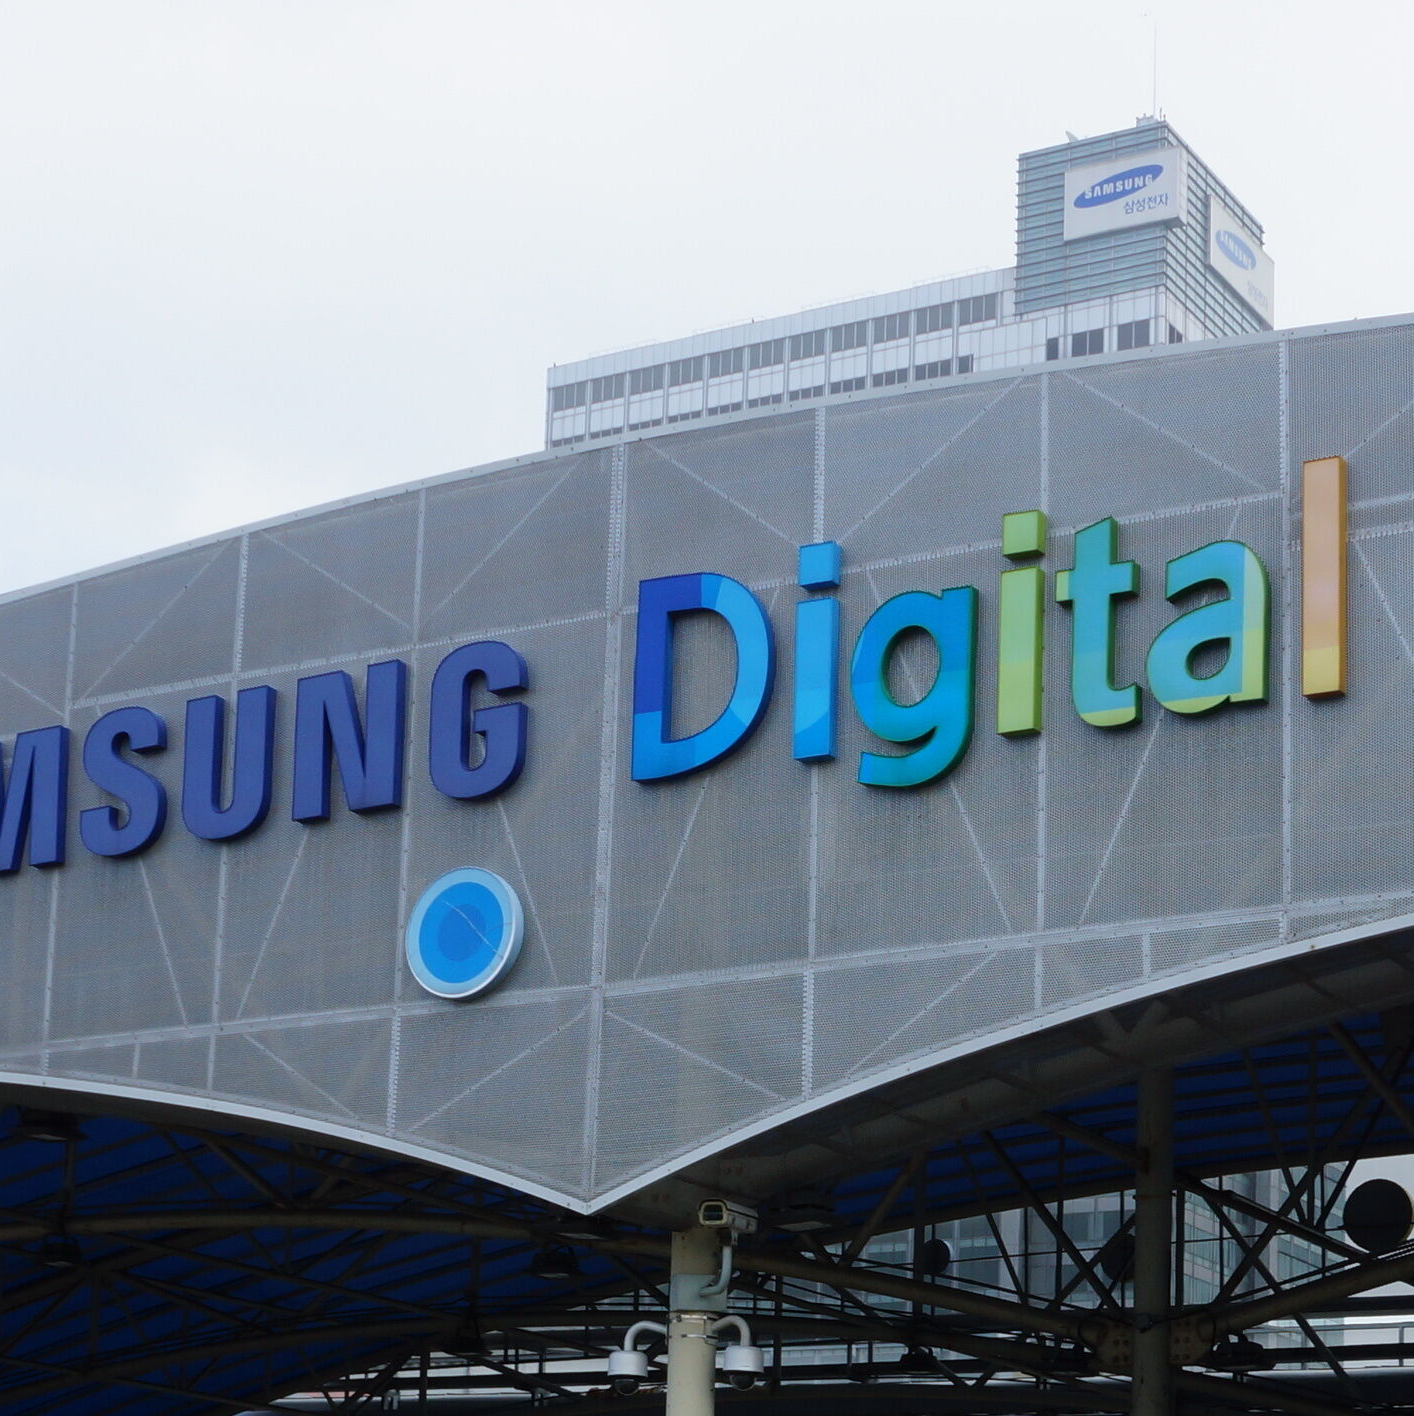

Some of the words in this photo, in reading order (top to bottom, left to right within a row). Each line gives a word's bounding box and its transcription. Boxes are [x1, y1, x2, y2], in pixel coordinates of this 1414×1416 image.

[1084, 173, 1153, 199] SAMSUNG
[1124, 193, 1168, 215] 삼성전자
[631, 455, 1348, 789] Digital
